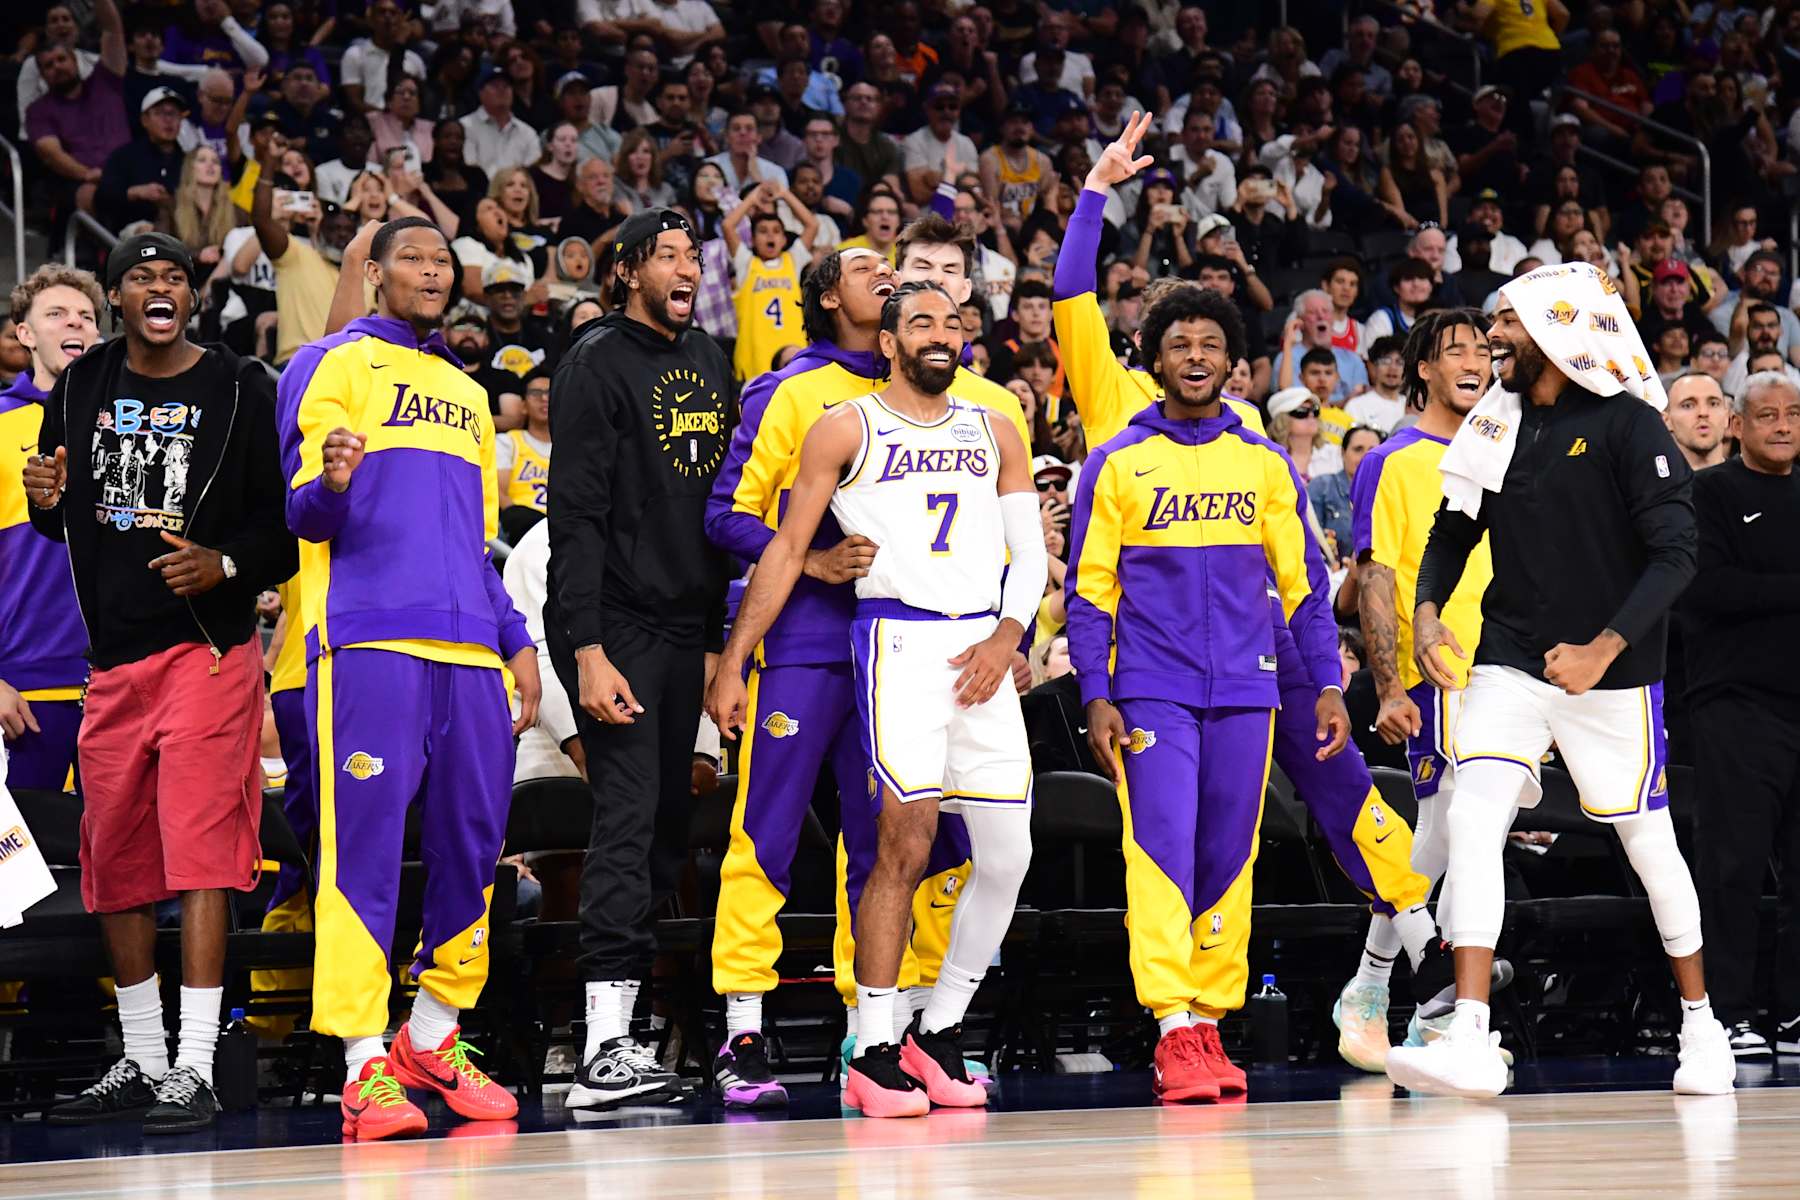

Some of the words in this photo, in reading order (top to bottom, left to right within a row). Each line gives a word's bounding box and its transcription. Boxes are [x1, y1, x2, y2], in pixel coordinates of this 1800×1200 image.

[765, 297, 783, 327] 4
[381, 383, 480, 445] LAKERS
[668, 407, 719, 437] LAKERS
[953, 427, 980, 438] bibigo
[875, 443, 989, 484] LAKERS
[925, 491, 960, 556] 7
[1142, 486, 1257, 531] LAKERS
